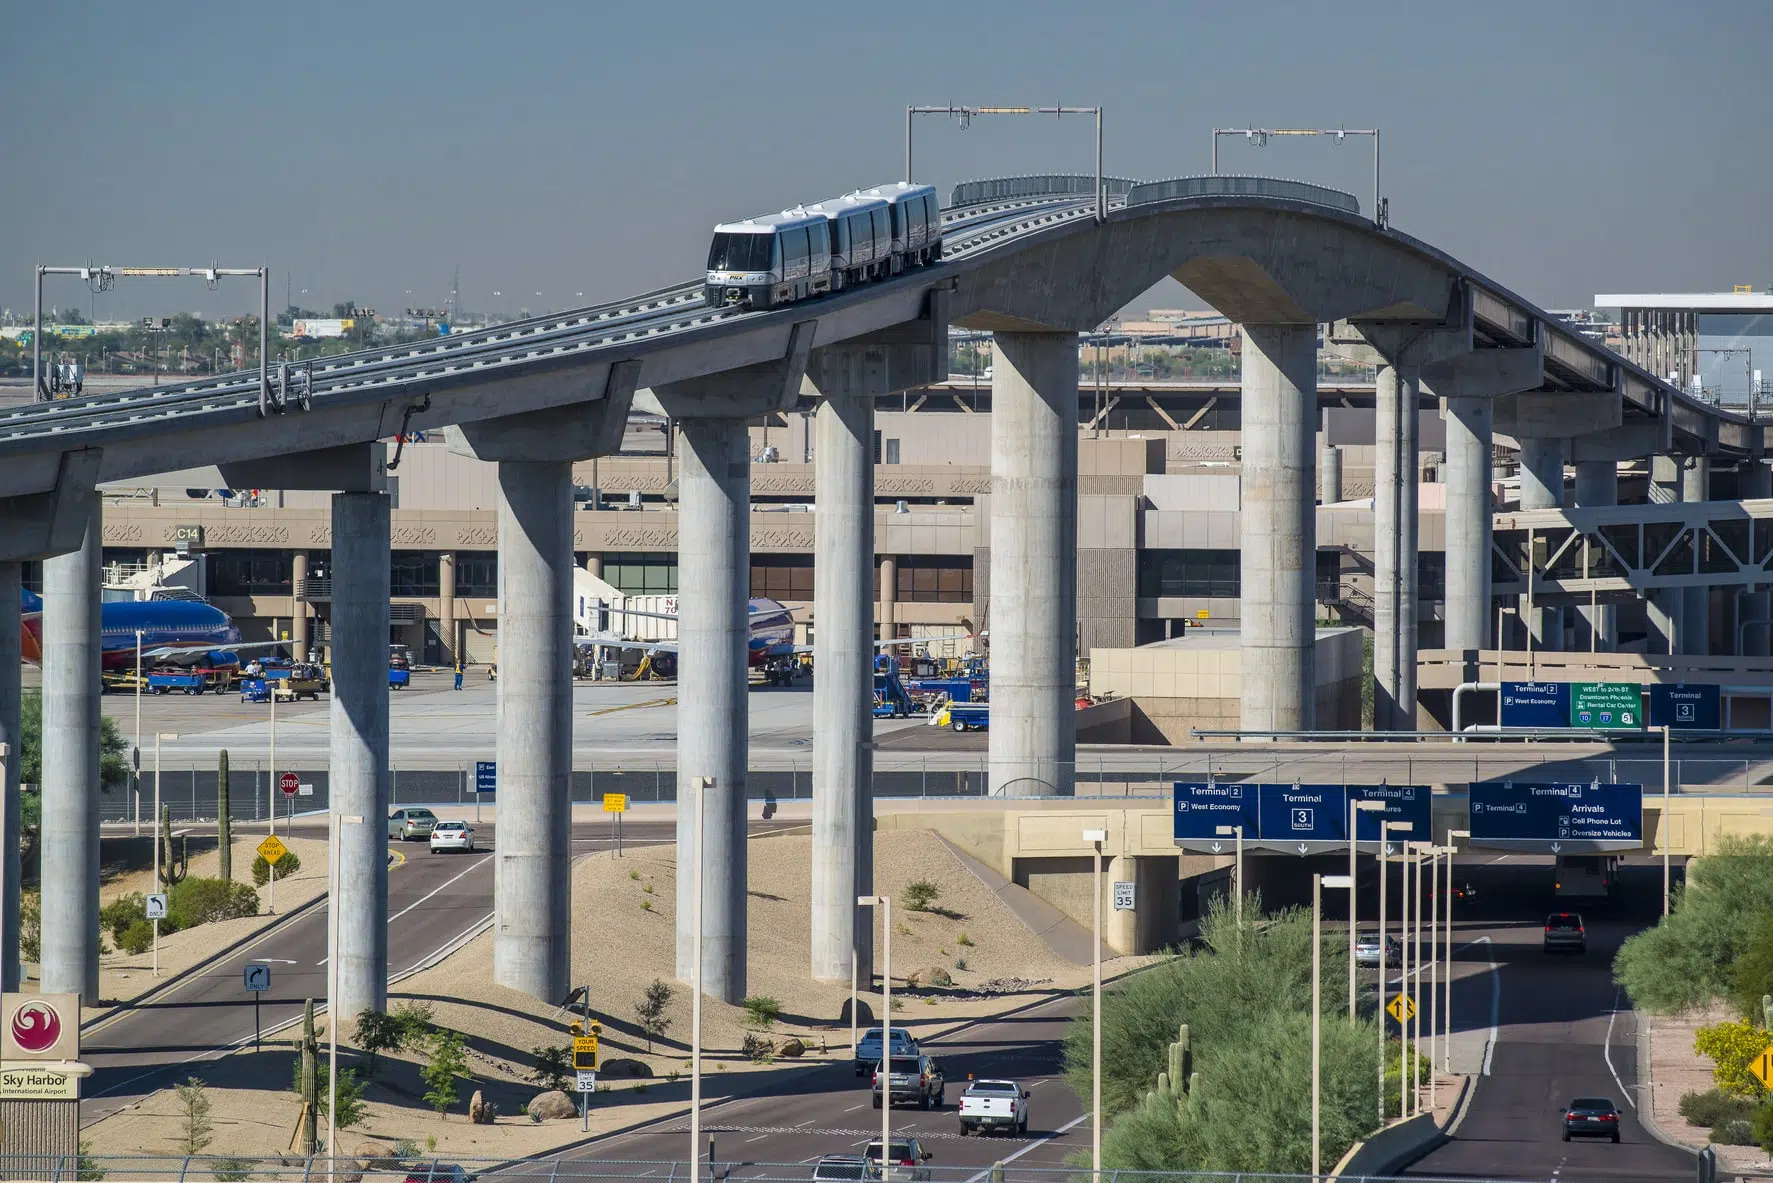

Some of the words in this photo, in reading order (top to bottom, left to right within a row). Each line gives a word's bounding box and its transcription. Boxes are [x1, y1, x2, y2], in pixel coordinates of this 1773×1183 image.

[178, 529, 198, 539] C14
[1682, 706, 1688, 715] 3
[281, 780, 298, 788] STOP
[1190, 787, 1229, 796] Terminal
[1363, 789, 1401, 797] Terminal
[1530, 787, 1568, 796] Terminal
[1283, 794, 1322, 802] Terminal
[1210, 804, 1241, 812] Economy
[1572, 804, 1605, 812] Arrivals
[1298, 811, 1307, 822] 3
[1117, 897, 1131, 905] 35
[3, 1075, 23, 1087] Sky
[27, 1075, 67, 1085] Harbor
